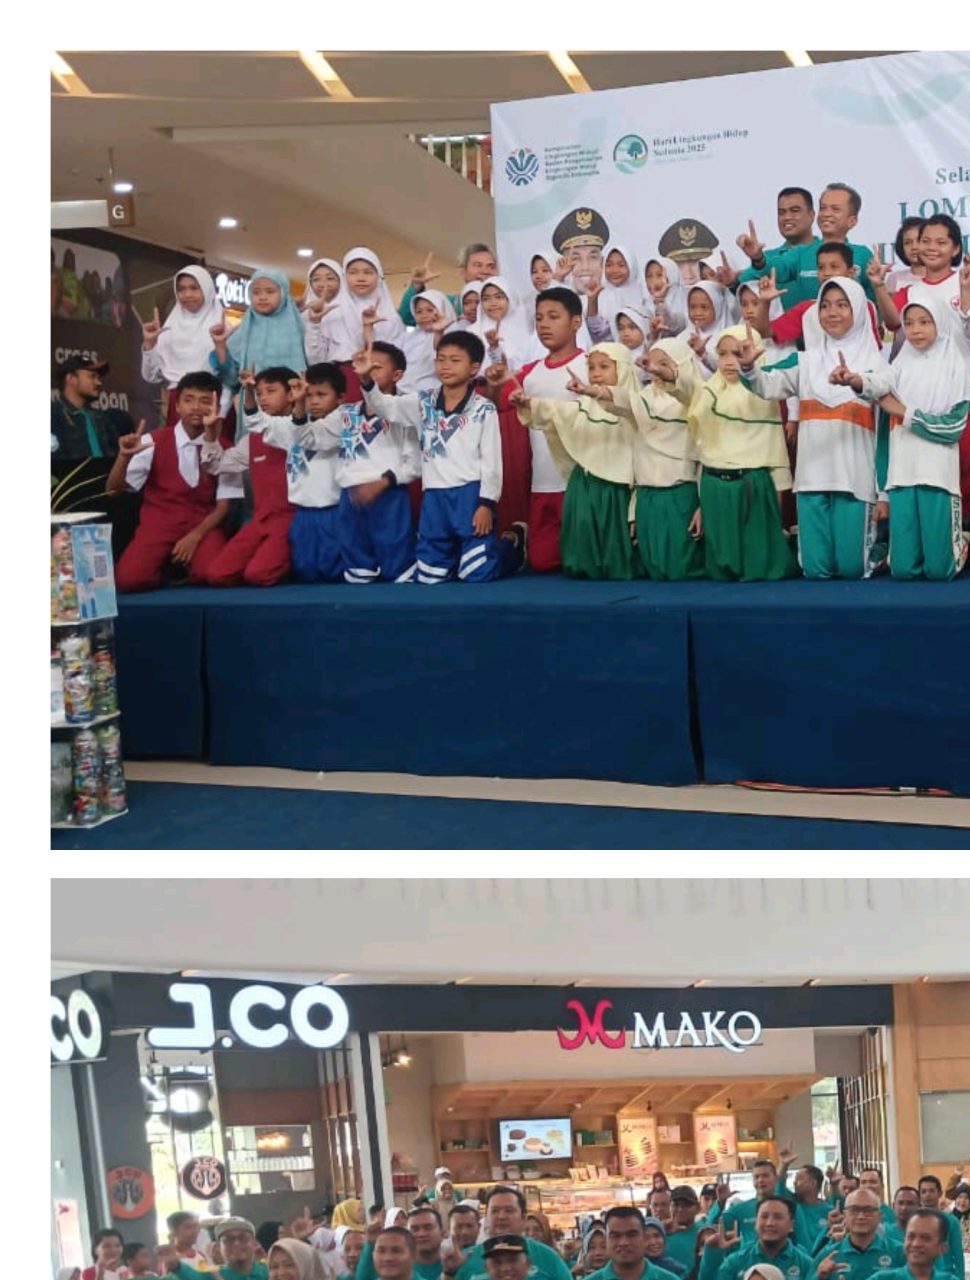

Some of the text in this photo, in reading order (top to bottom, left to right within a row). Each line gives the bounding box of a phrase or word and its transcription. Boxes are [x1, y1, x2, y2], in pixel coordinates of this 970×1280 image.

[112, 205, 125, 220] G
[147, 982, 350, 1049] J.CO
[631, 1011, 762, 1053] MAKO
